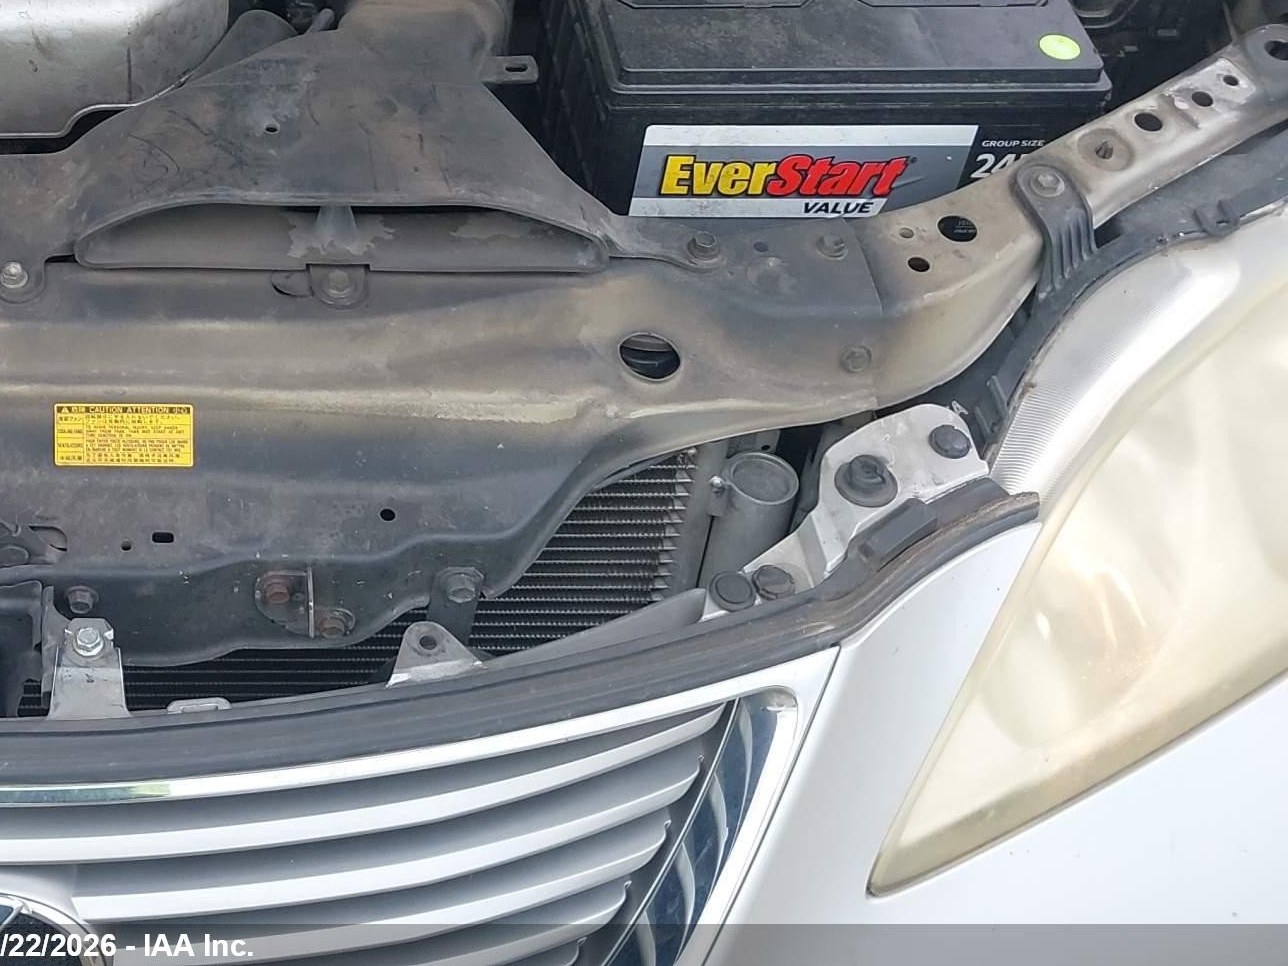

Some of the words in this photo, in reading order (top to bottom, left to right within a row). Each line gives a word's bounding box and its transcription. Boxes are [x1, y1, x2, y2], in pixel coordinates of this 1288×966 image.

[1020, 139, 1046, 147] SIZE
[660, 153, 909, 197] EverStart
[803, 201, 873, 214] VALUE
[127, 406, 169, 414] ATTENTION
